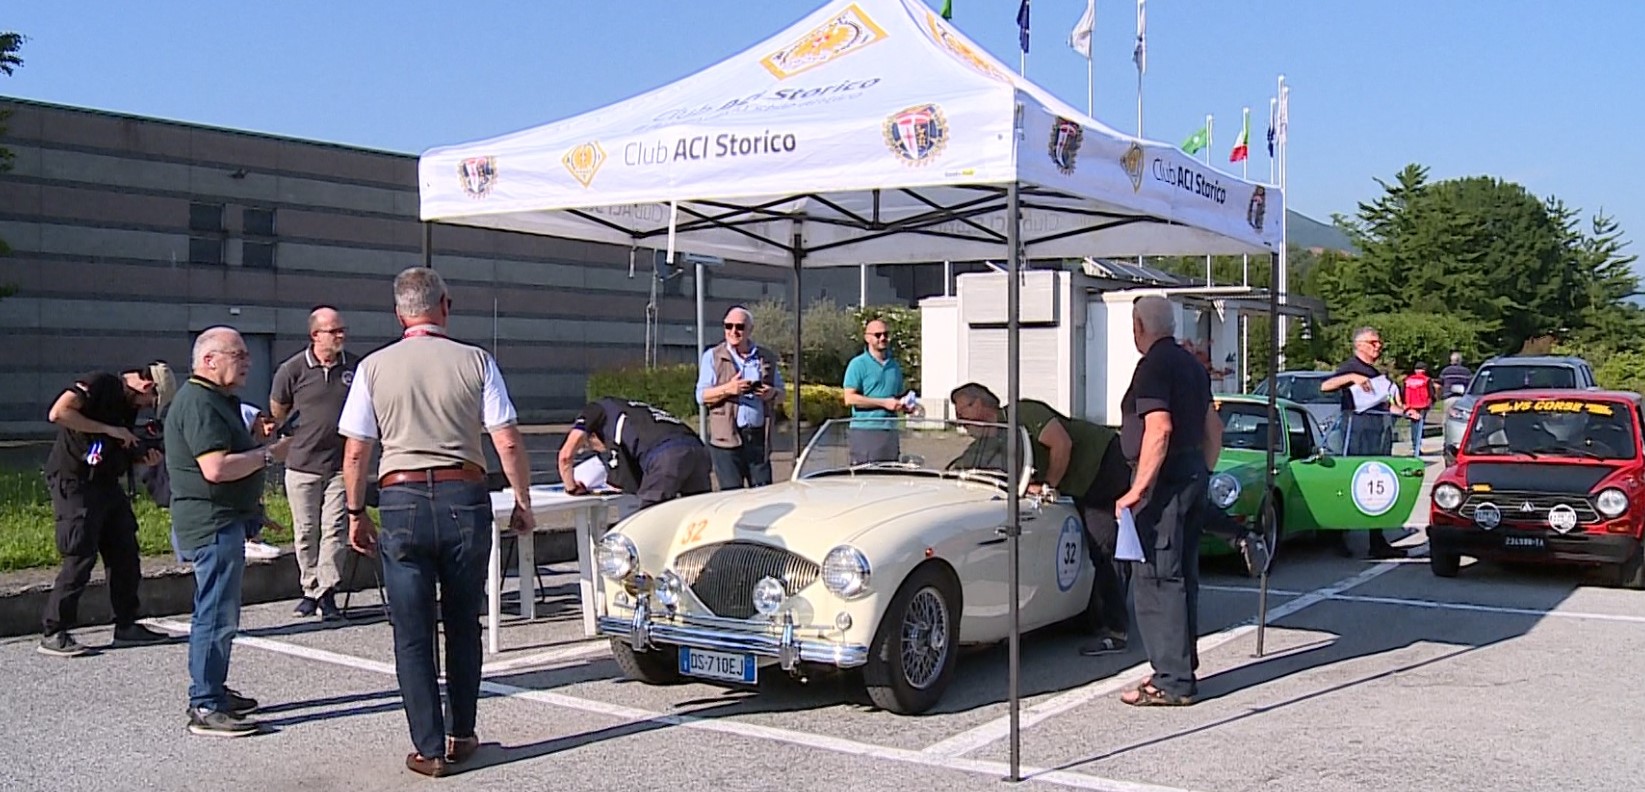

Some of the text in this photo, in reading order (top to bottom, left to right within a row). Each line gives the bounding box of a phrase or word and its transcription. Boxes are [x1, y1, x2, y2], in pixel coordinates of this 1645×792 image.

[769, 77, 882, 101] Storico
[624, 129, 797, 166] Club ACI Storico
[1152, 156, 1227, 205] Club ACI Storico
[1533, 400, 1584, 413] CORSE
[1367, 479, 1385, 495] 15
[681, 519, 708, 545] 32
[1064, 542, 1077, 564] 32
